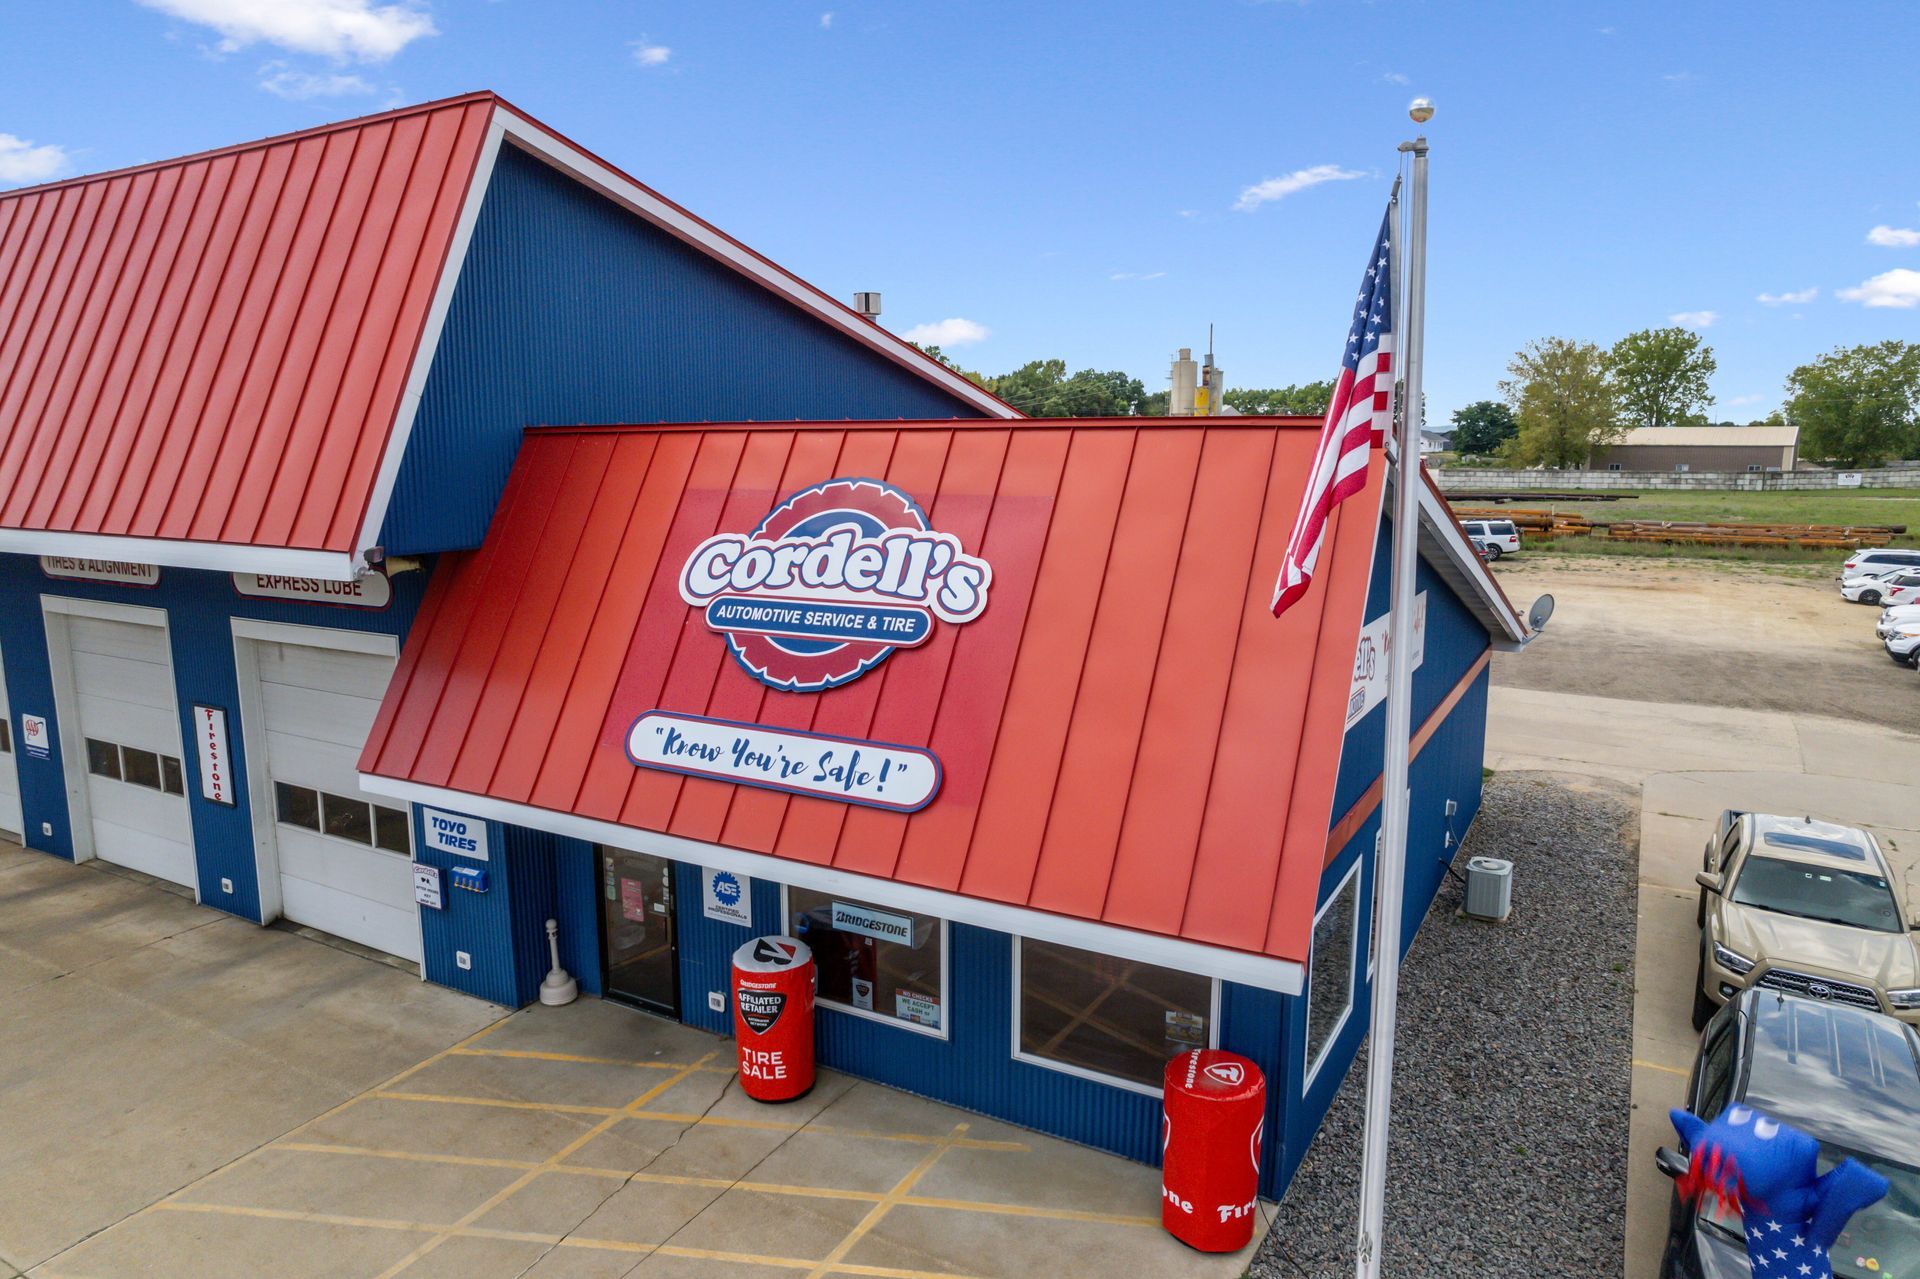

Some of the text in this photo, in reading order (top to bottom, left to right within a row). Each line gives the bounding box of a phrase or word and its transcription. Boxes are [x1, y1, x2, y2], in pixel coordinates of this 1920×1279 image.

[79, 559, 86, 571] &
[88, 559, 152, 578] ALIGNMENT
[685, 527, 986, 615] Cordell's
[256, 573, 320, 593] EXPRESS
[716, 604, 916, 633] AUTOMOTIVE SERVICE & TIRE
[204, 707, 222, 801] Firestone
[731, 737, 809, 779] You're
[431, 816, 467, 836] TOYO
[437, 831, 477, 852] TIRES
[716, 881, 737, 897] ASE
[835, 910, 908, 938] BRIDGESTONE
[738, 992, 782, 1005] AFFILIATED
[740, 1001, 778, 1014] RETAILER
[742, 1046, 783, 1065] TIRE
[742, 1060, 788, 1080] SALE
[1185, 1048, 1202, 1089] Firestone
